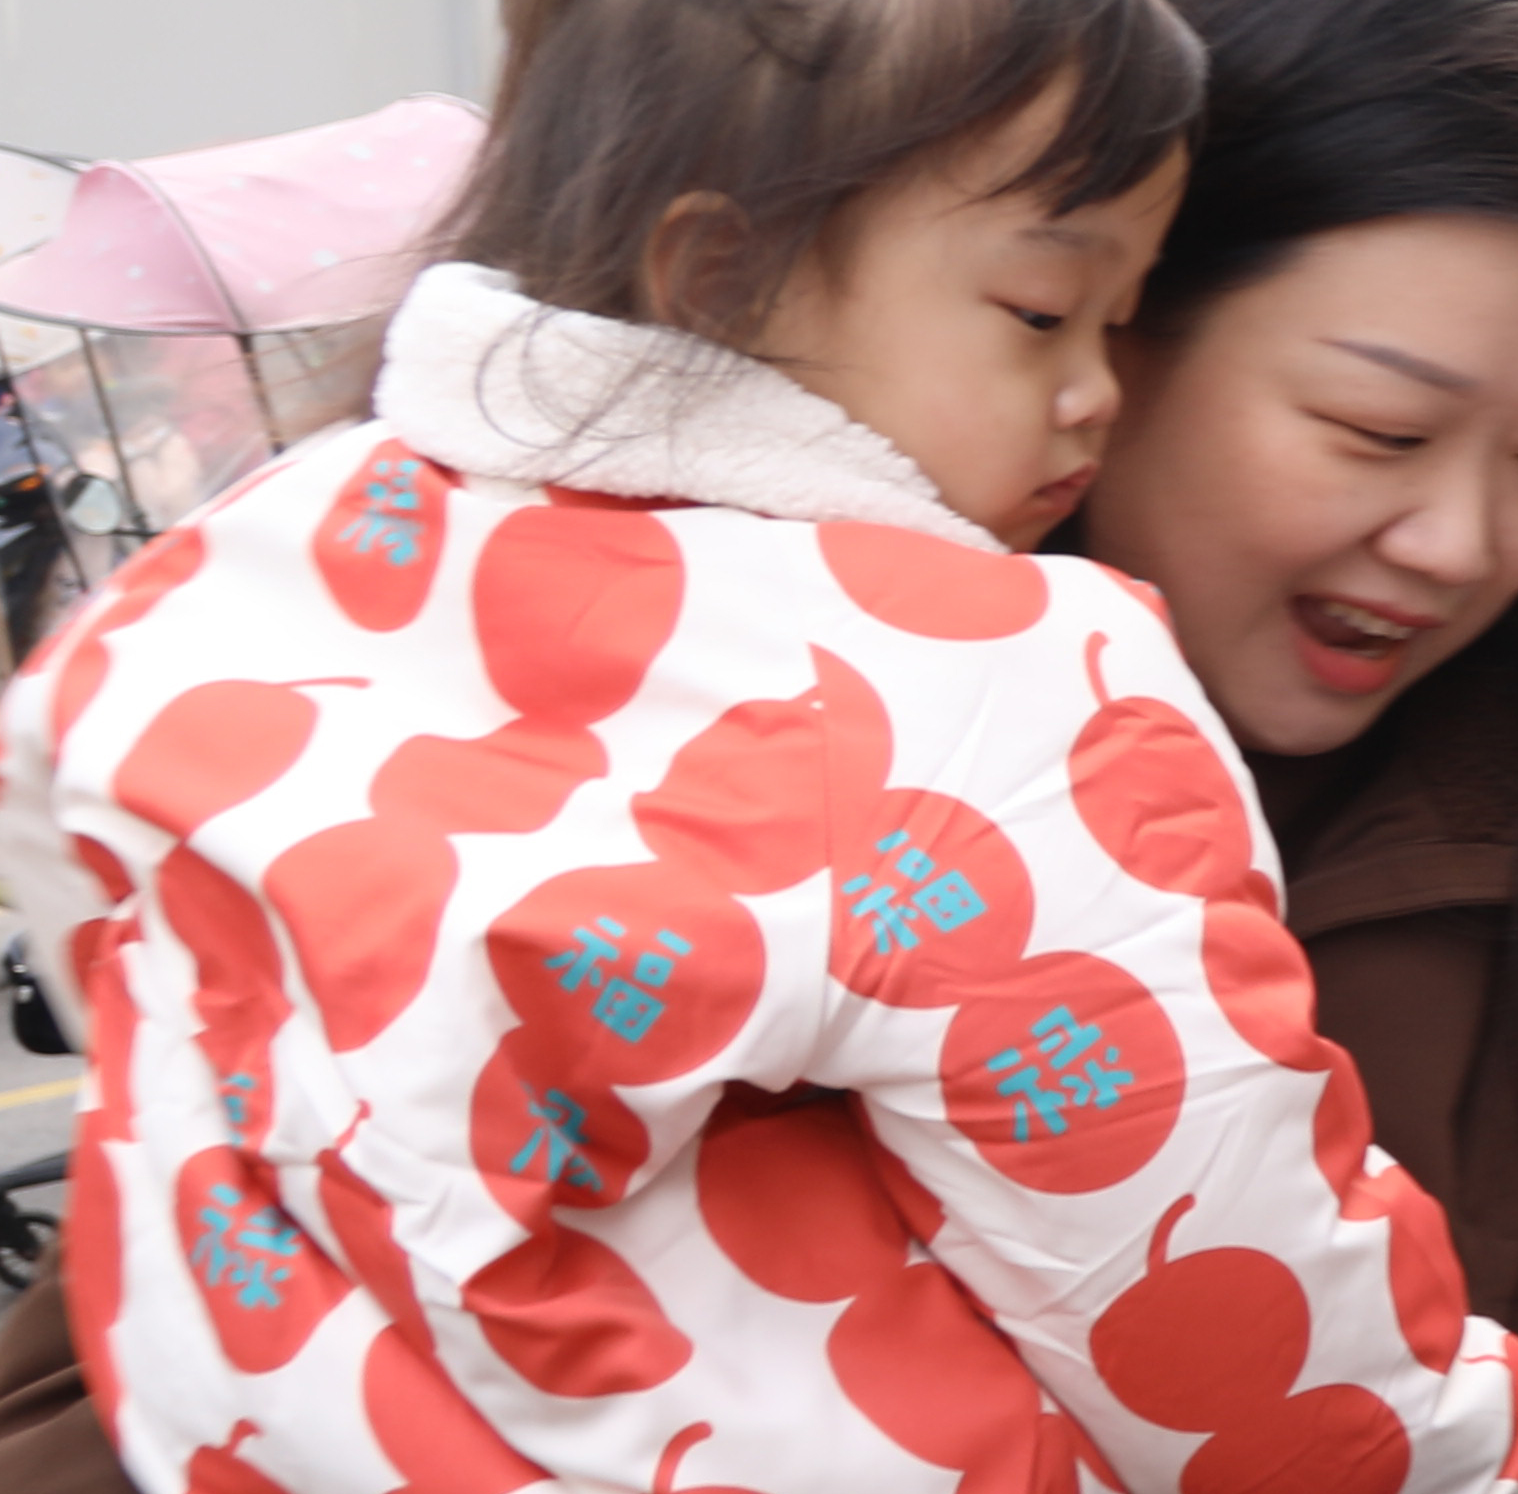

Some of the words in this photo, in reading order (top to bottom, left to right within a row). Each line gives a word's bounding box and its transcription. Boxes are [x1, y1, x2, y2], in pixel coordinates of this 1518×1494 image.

[841, 827, 988, 955] 福
[543, 915, 693, 1045] 福
[985, 1004, 1134, 1144] 禄
